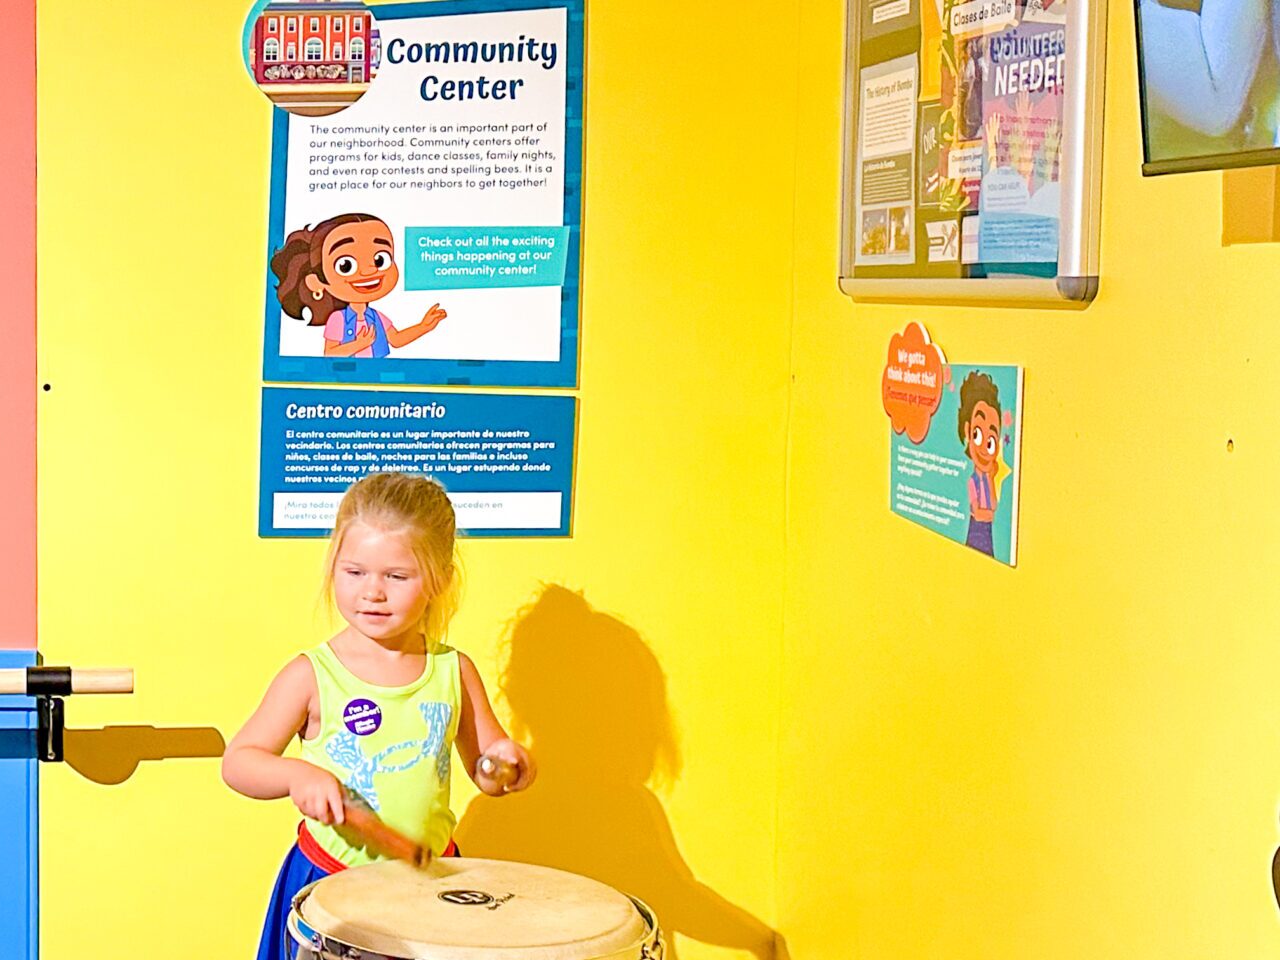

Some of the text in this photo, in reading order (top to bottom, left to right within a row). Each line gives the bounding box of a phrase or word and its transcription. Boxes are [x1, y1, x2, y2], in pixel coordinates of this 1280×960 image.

[953, 10, 977, 27] Clases
[978, 6, 989, 20] de
[990, 1, 1012, 17] Baile
[386, 34, 557, 69] Community
[419, 73, 523, 101] Center
[310, 124, 329, 134] The
[331, 124, 389, 135] community
[392, 124, 425, 133] center
[456, 123, 508, 134] important
[511, 123, 533, 133] part
[536, 122, 547, 131] of
[309, 135, 539, 150] our neighborhood. Community centers offer
[309, 149, 555, 164] programs for kids, dance classes, family nights,
[417, 235, 554, 248] Check out all the exciting
[420, 250, 552, 264] things happening at our
[434, 263, 536, 277] community center!
[897, 349, 925, 368] We gotta
[887, 366, 936, 388] think about this!
[285, 401, 445, 418] Centro comunitario
[285, 440, 555, 450] vecindario. Los centros comunitarios ofrecen programas para
